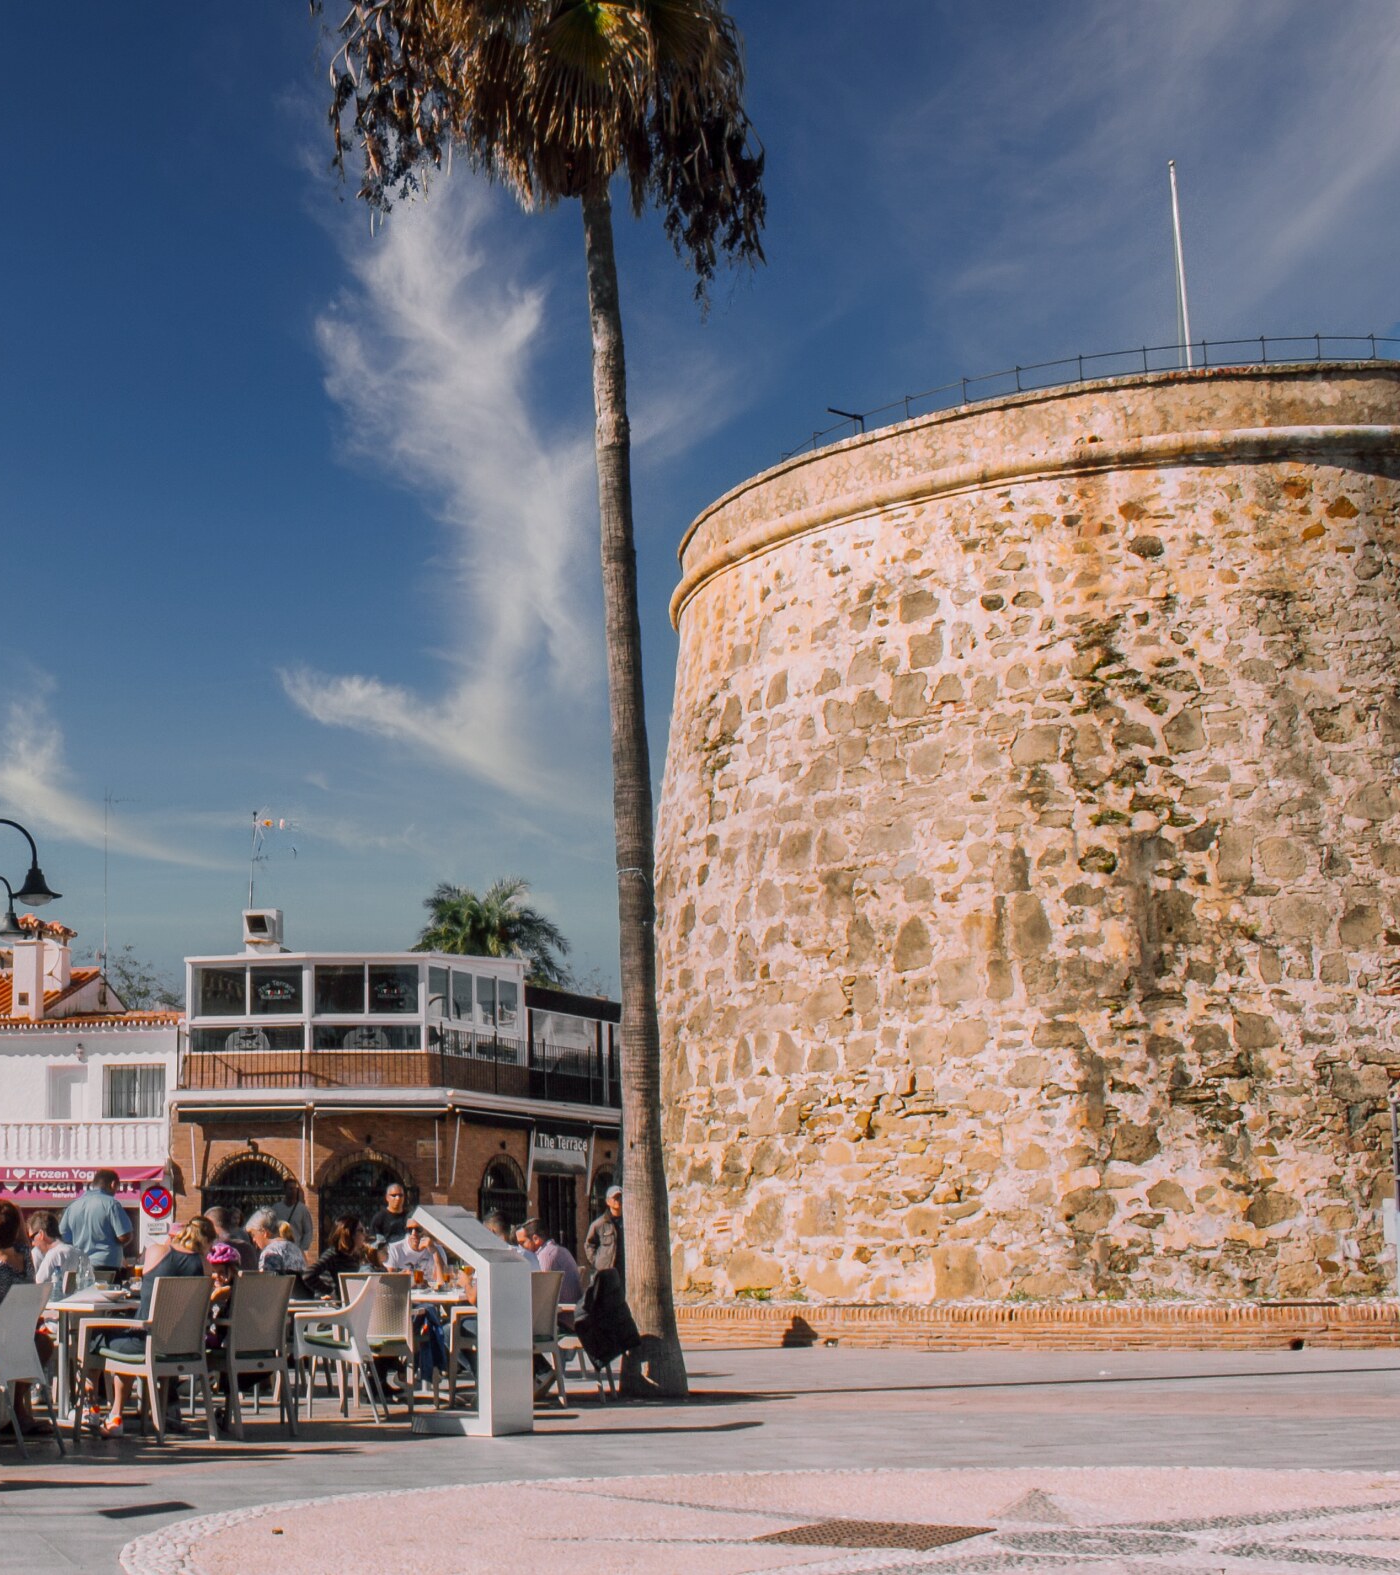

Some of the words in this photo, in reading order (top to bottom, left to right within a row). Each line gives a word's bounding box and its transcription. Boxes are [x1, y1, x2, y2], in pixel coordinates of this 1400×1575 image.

[538, 1133, 554, 1149] The
[556, 1135, 588, 1151] Terrace
[28, 1169, 69, 1179] Frozen
